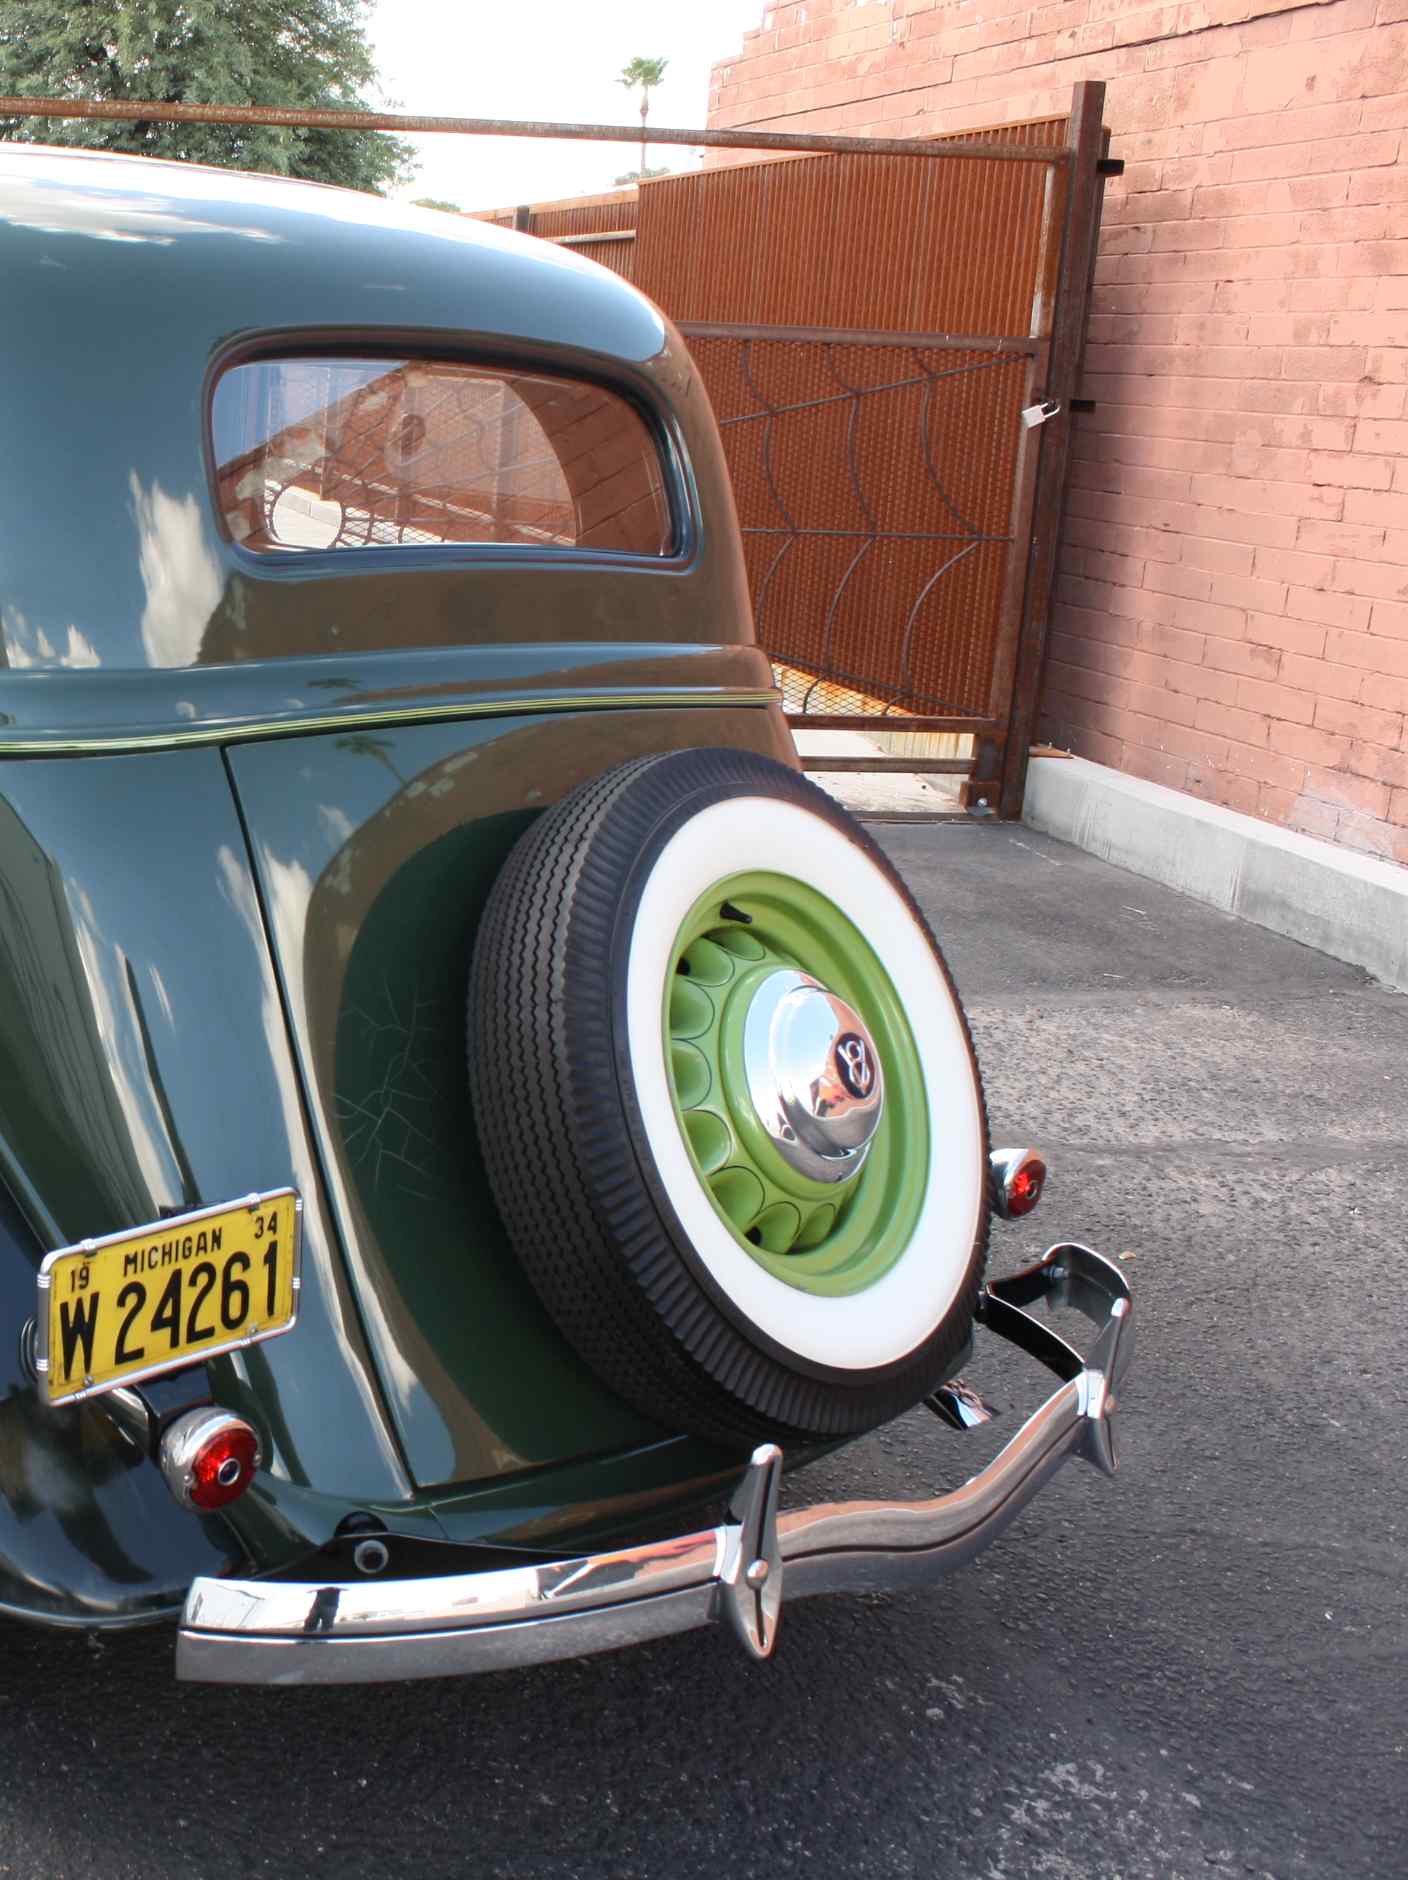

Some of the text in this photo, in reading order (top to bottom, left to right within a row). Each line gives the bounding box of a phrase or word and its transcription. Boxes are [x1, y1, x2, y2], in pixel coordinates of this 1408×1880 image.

[70, 1211, 279, 1293] 19 MICHIGAN 34
[59, 1240, 279, 1382] W 24261
